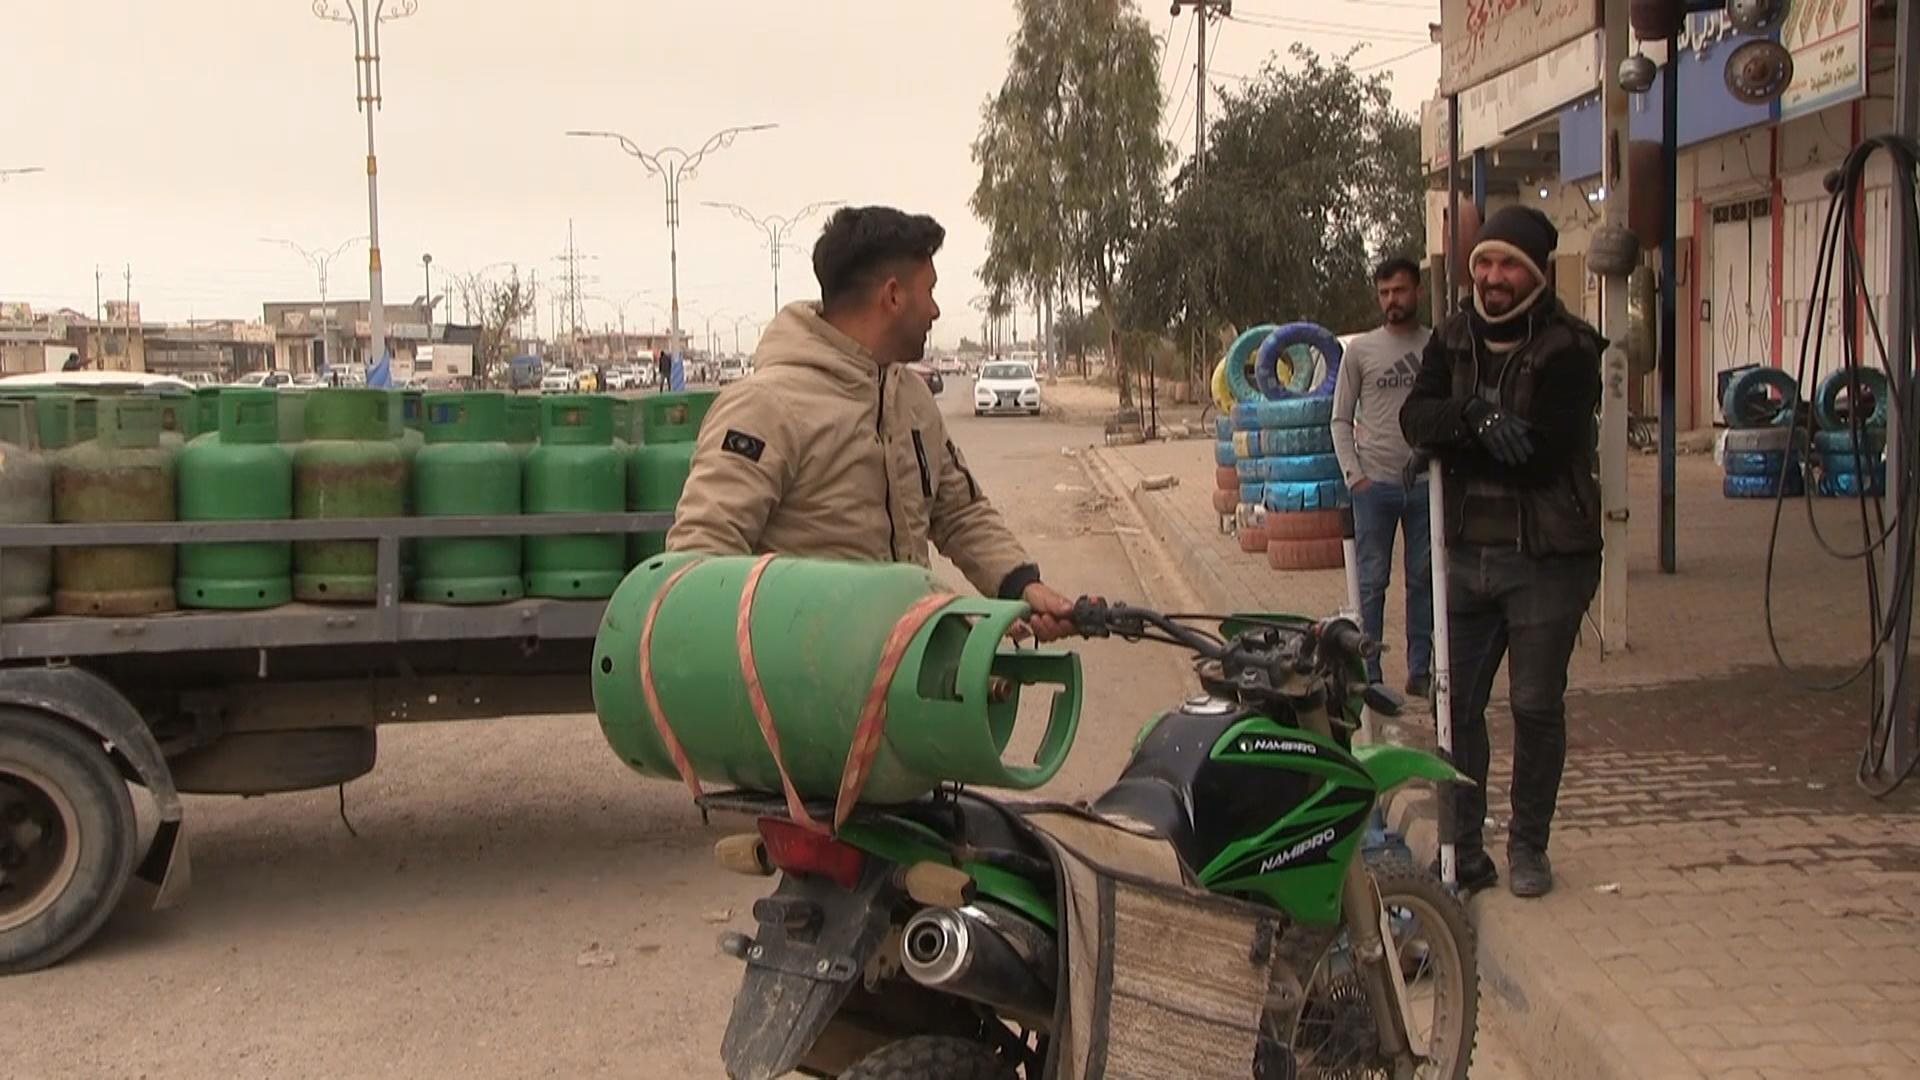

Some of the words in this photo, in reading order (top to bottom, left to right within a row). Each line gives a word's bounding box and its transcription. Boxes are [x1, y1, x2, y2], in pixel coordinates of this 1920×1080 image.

[1376, 374, 1416, 388] adid
[1254, 739, 1317, 754] NAMIPRO
[1259, 828, 1336, 875] NAMIPRO
